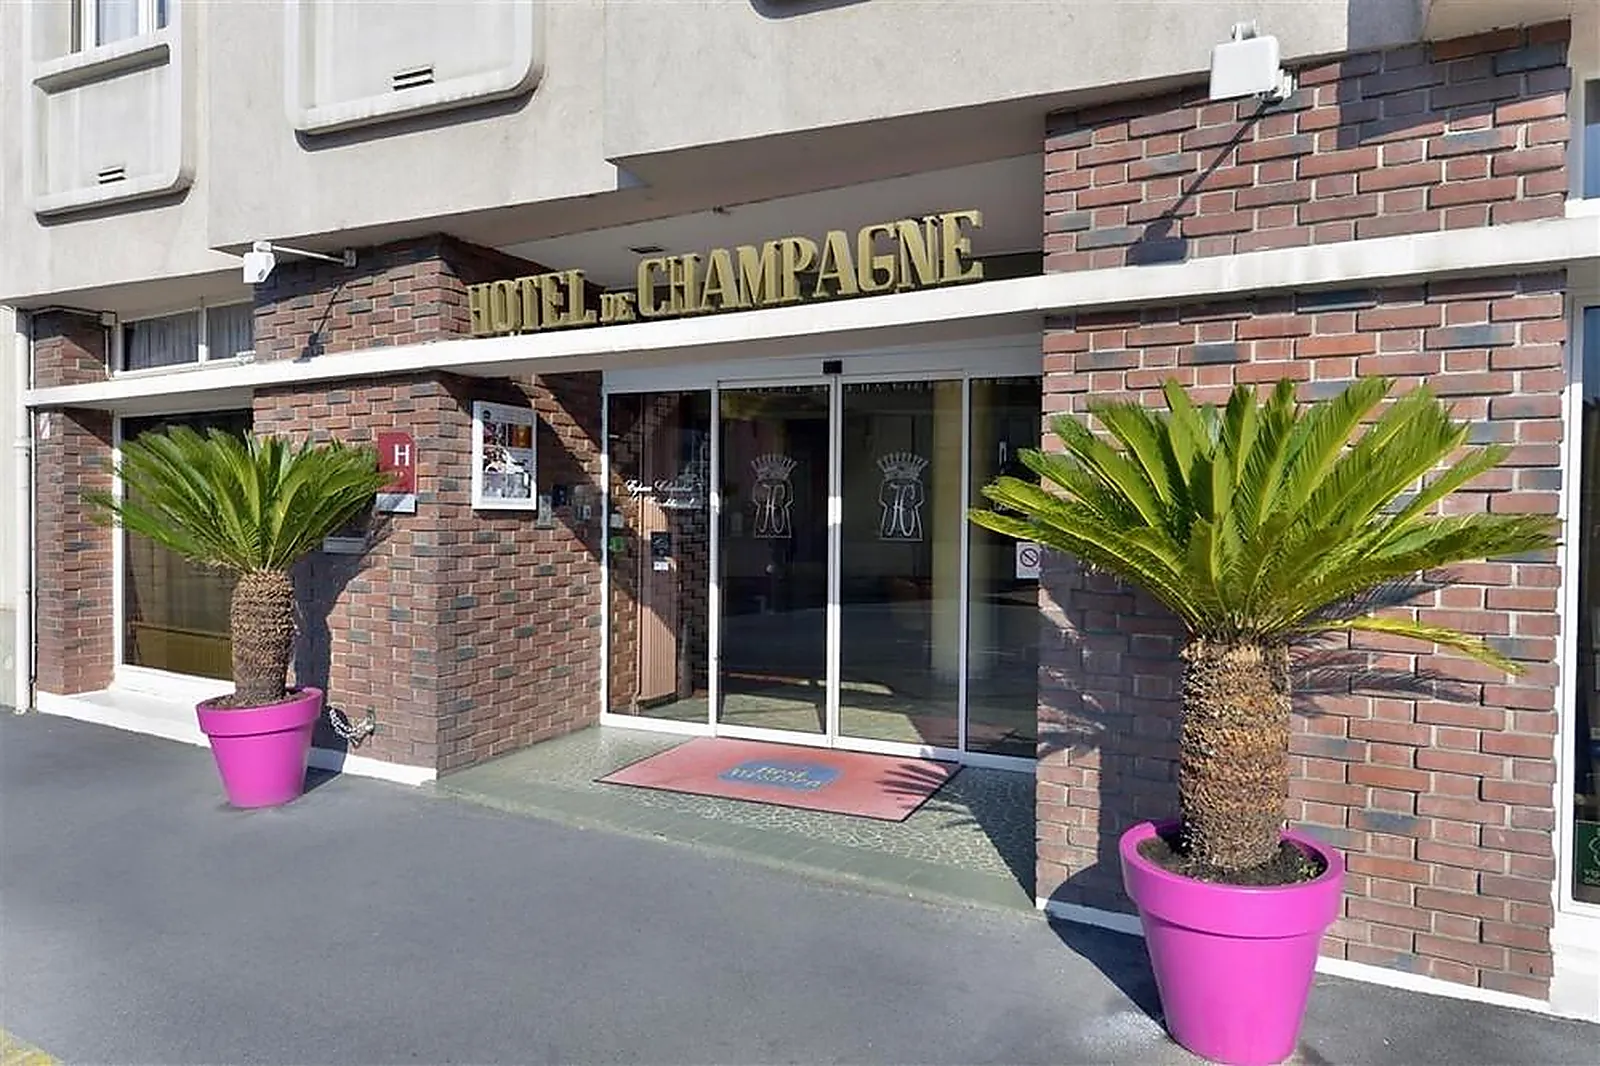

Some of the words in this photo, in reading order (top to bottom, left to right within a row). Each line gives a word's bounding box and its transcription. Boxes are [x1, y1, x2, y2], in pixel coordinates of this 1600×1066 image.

[468, 269, 598, 337] HOTEL
[600, 292, 636, 323] DE
[637, 209, 985, 318] CHAMPAGNE
[394, 444, 412, 467] H
